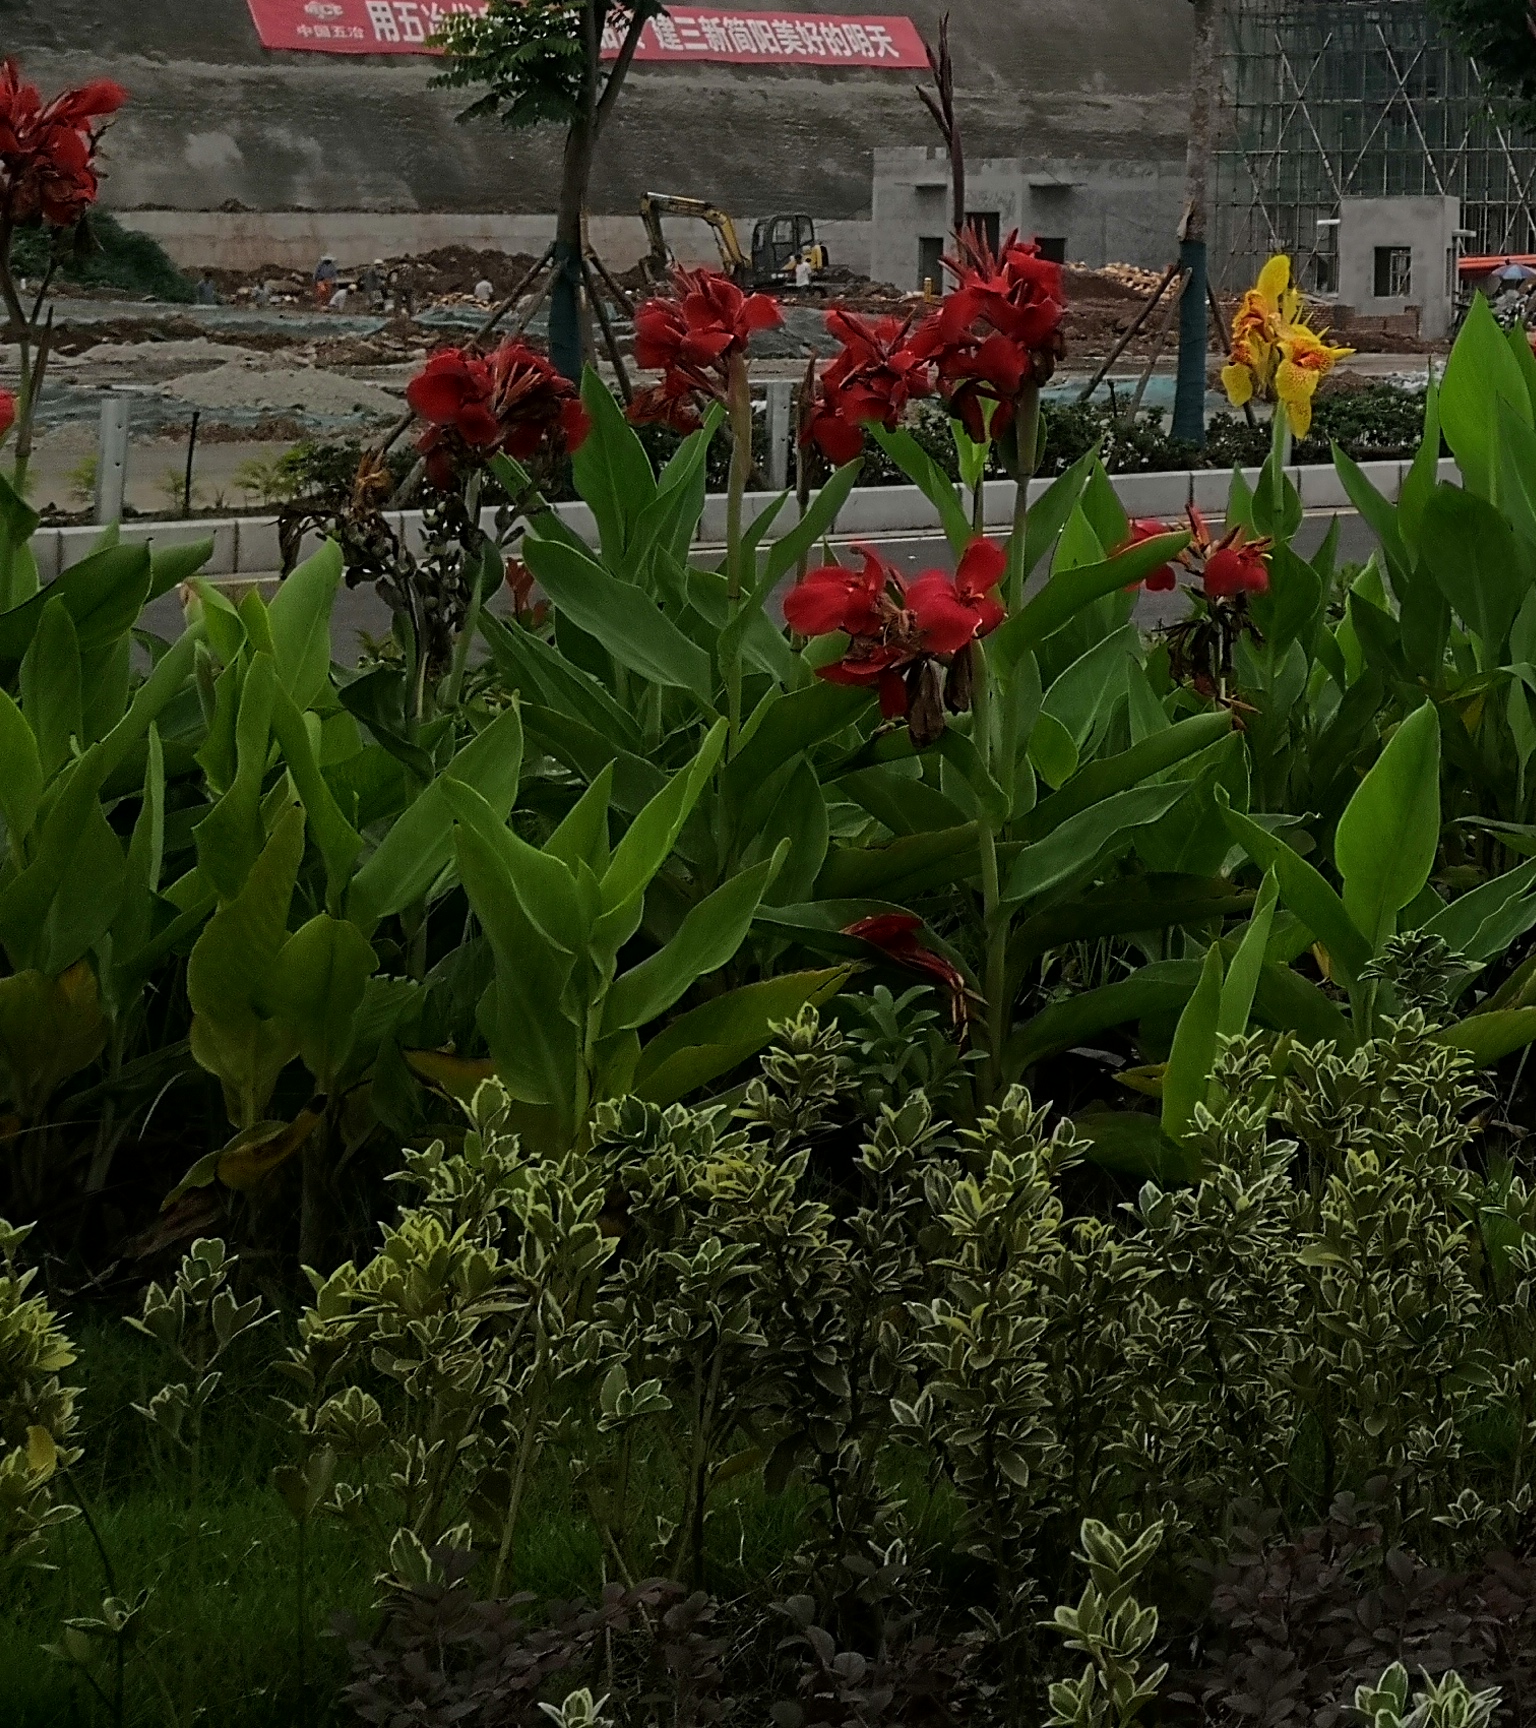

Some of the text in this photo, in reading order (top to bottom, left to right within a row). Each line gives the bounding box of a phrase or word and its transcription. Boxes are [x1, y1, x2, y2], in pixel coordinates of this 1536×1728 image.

[648, 13, 899, 58] 建三新简阳美好的明天
